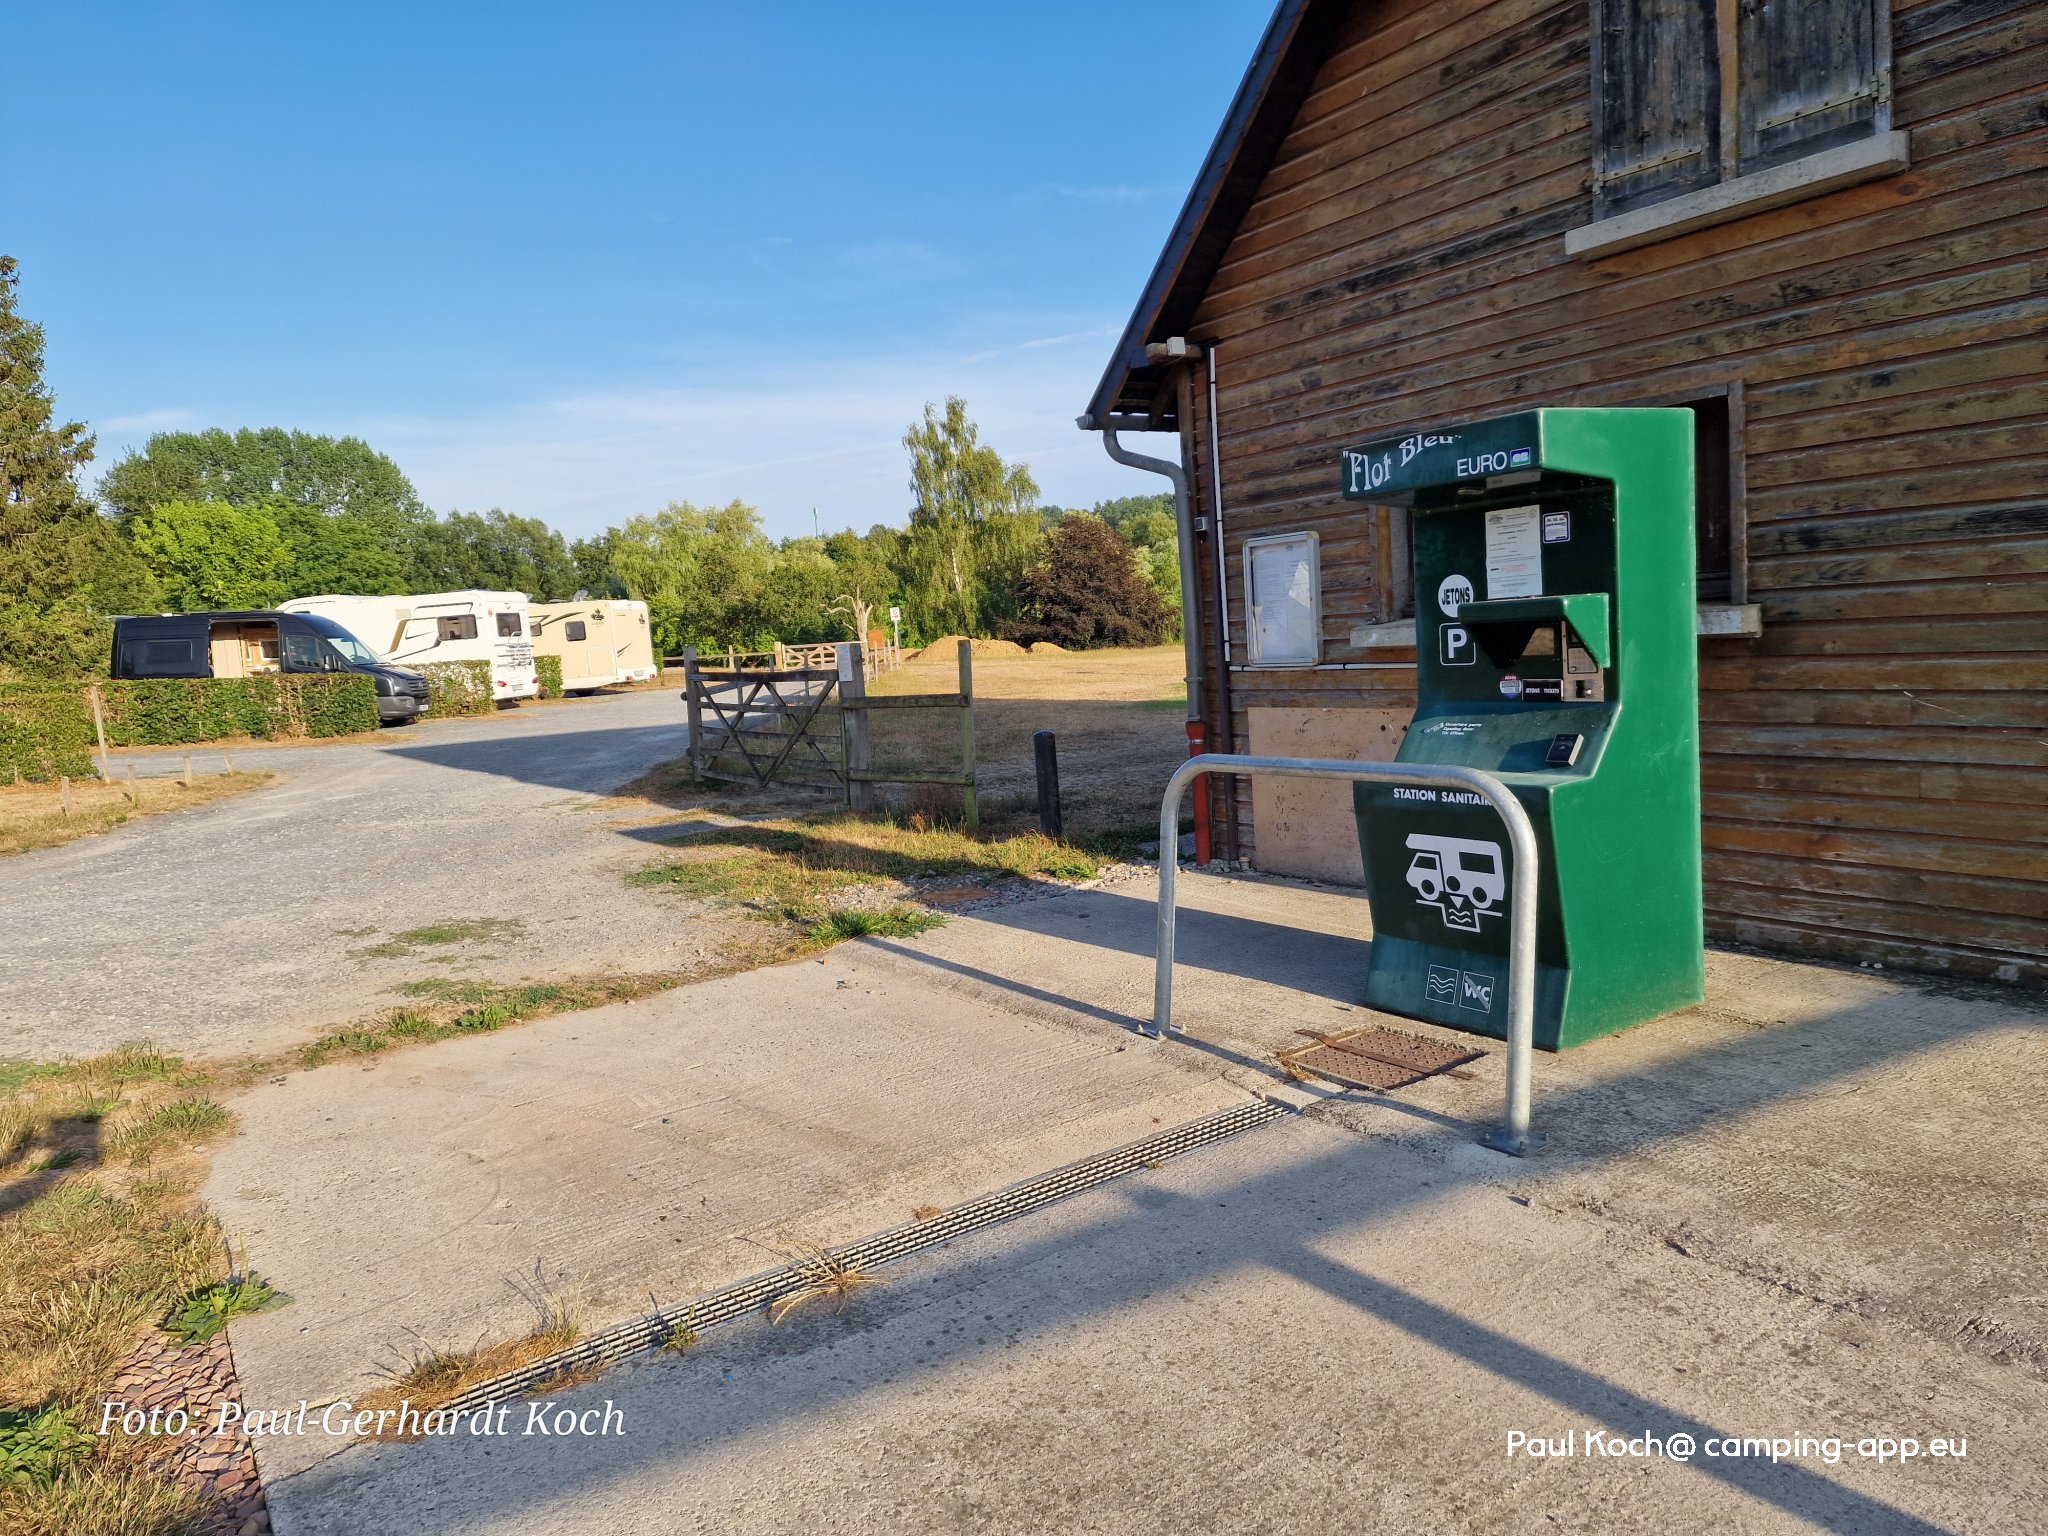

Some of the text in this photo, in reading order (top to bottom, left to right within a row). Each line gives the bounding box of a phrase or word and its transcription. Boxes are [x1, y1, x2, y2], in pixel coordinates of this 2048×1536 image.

[1457, 451, 1508, 477] EURO
[1442, 586, 1471, 606] JETONS
[1447, 628, 1467, 659] P
[1393, 788, 1436, 801] STATION
[1464, 983, 1490, 1001] WC
